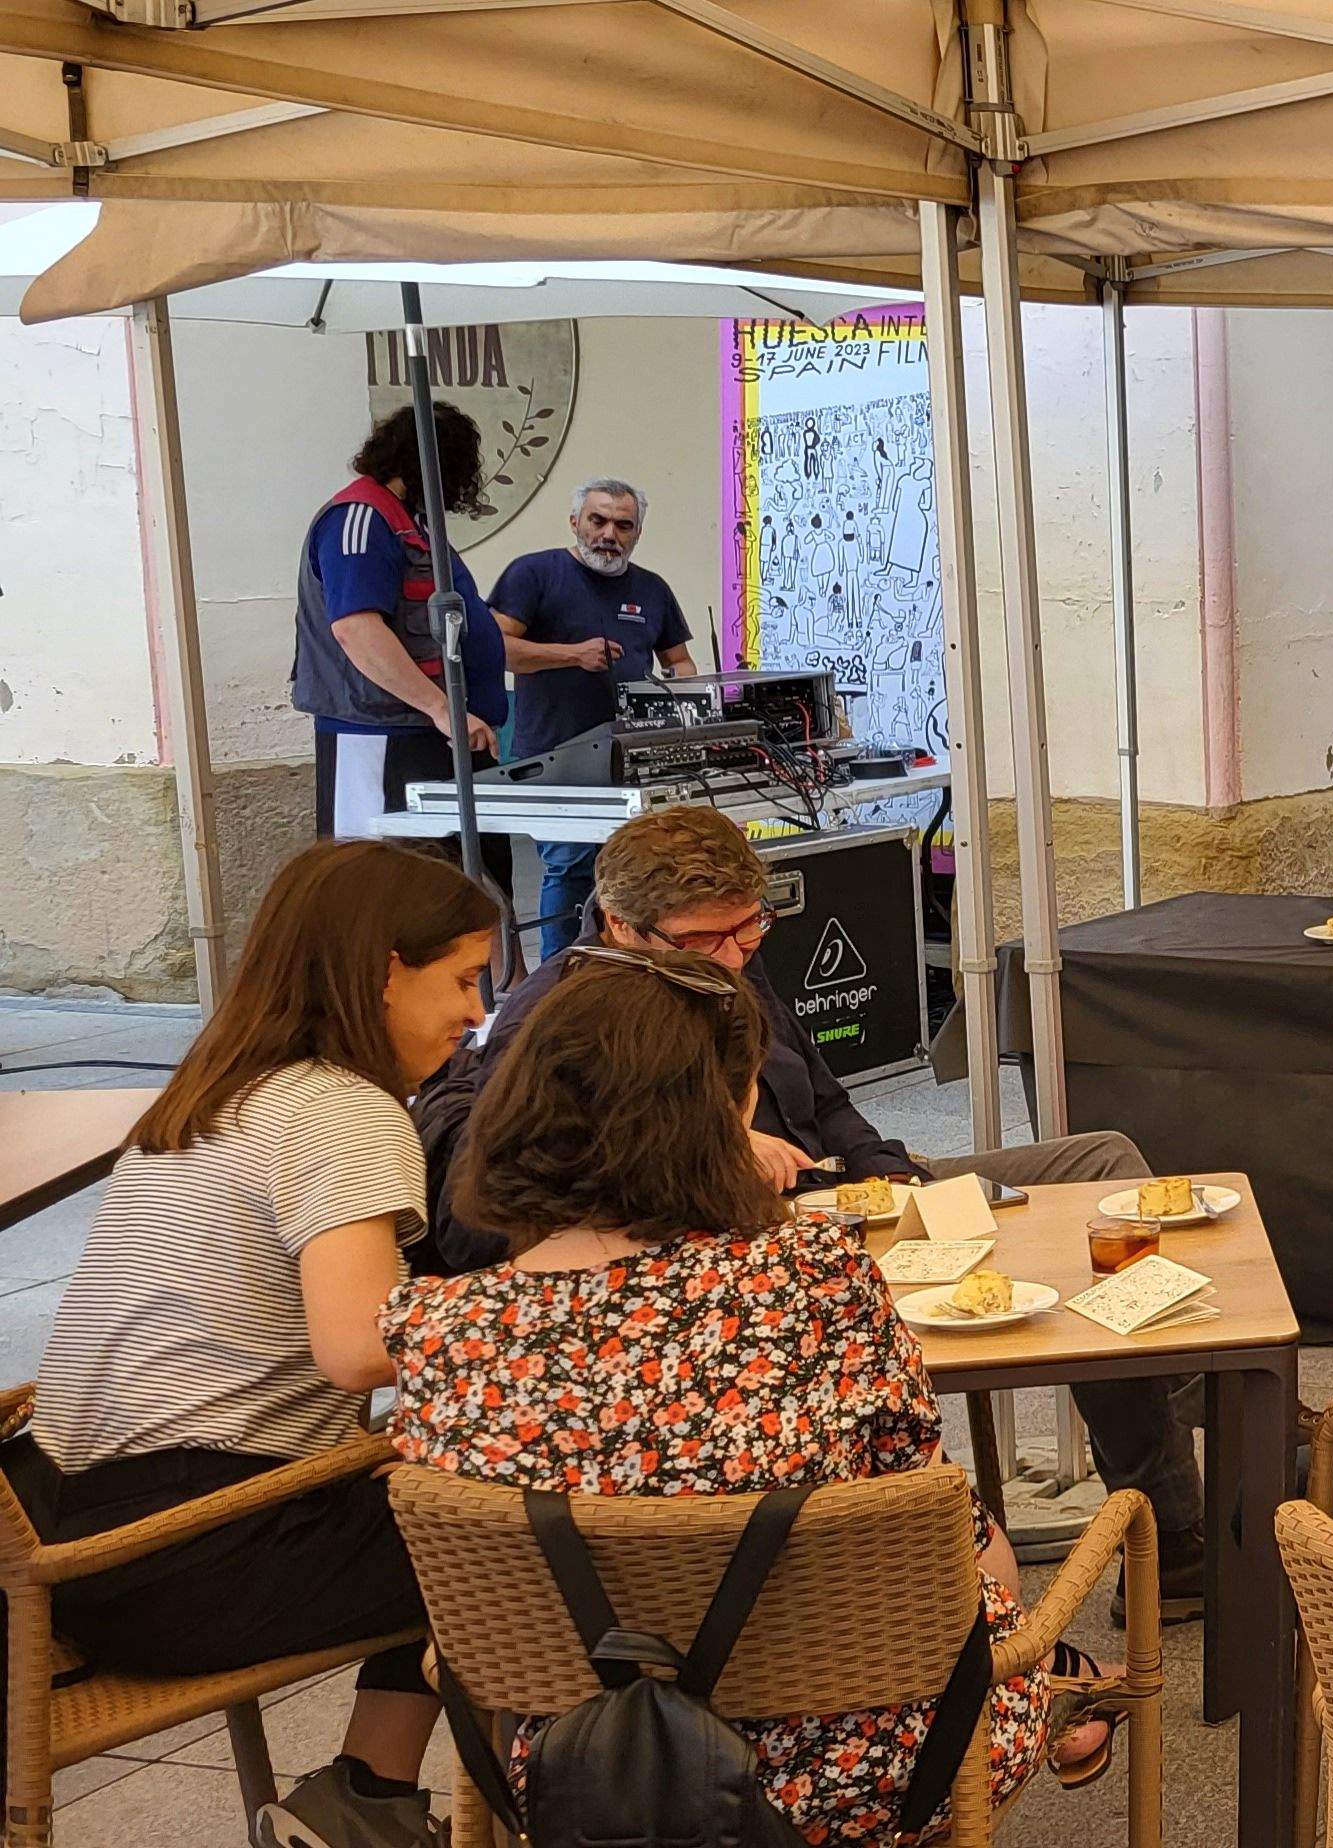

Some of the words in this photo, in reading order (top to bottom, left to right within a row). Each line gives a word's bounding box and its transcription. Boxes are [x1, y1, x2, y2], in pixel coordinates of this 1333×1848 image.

[731, 352, 777, 368] 9-17
[782, 346, 826, 363] JUNE
[835, 343, 871, 357] 2023
[734, 356, 867, 383] SPAIN
[795, 985, 878, 1017] behringer
[817, 1024, 860, 1043] SHURE
